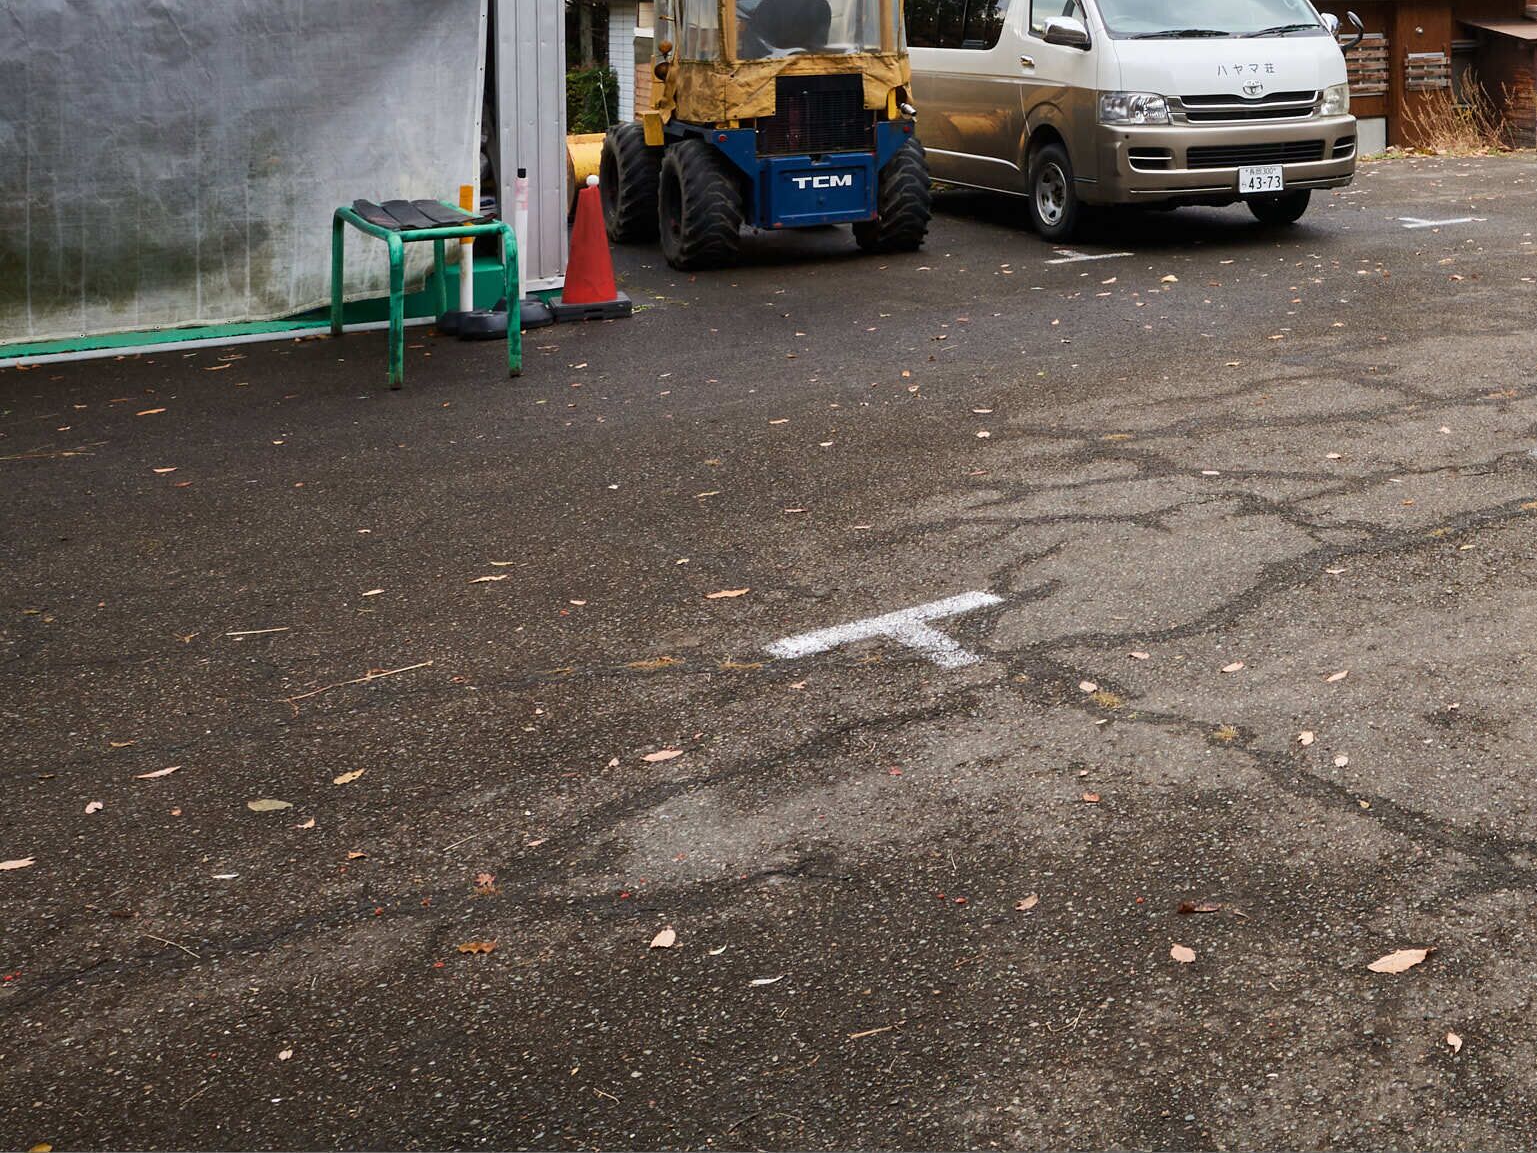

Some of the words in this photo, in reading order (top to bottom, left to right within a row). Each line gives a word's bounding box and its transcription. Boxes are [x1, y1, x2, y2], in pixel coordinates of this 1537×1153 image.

[1217, 63, 1275, 76] ハヤマ荘
[792, 174, 852, 189] TCM
[1248, 175, 1281, 190] 43-73
